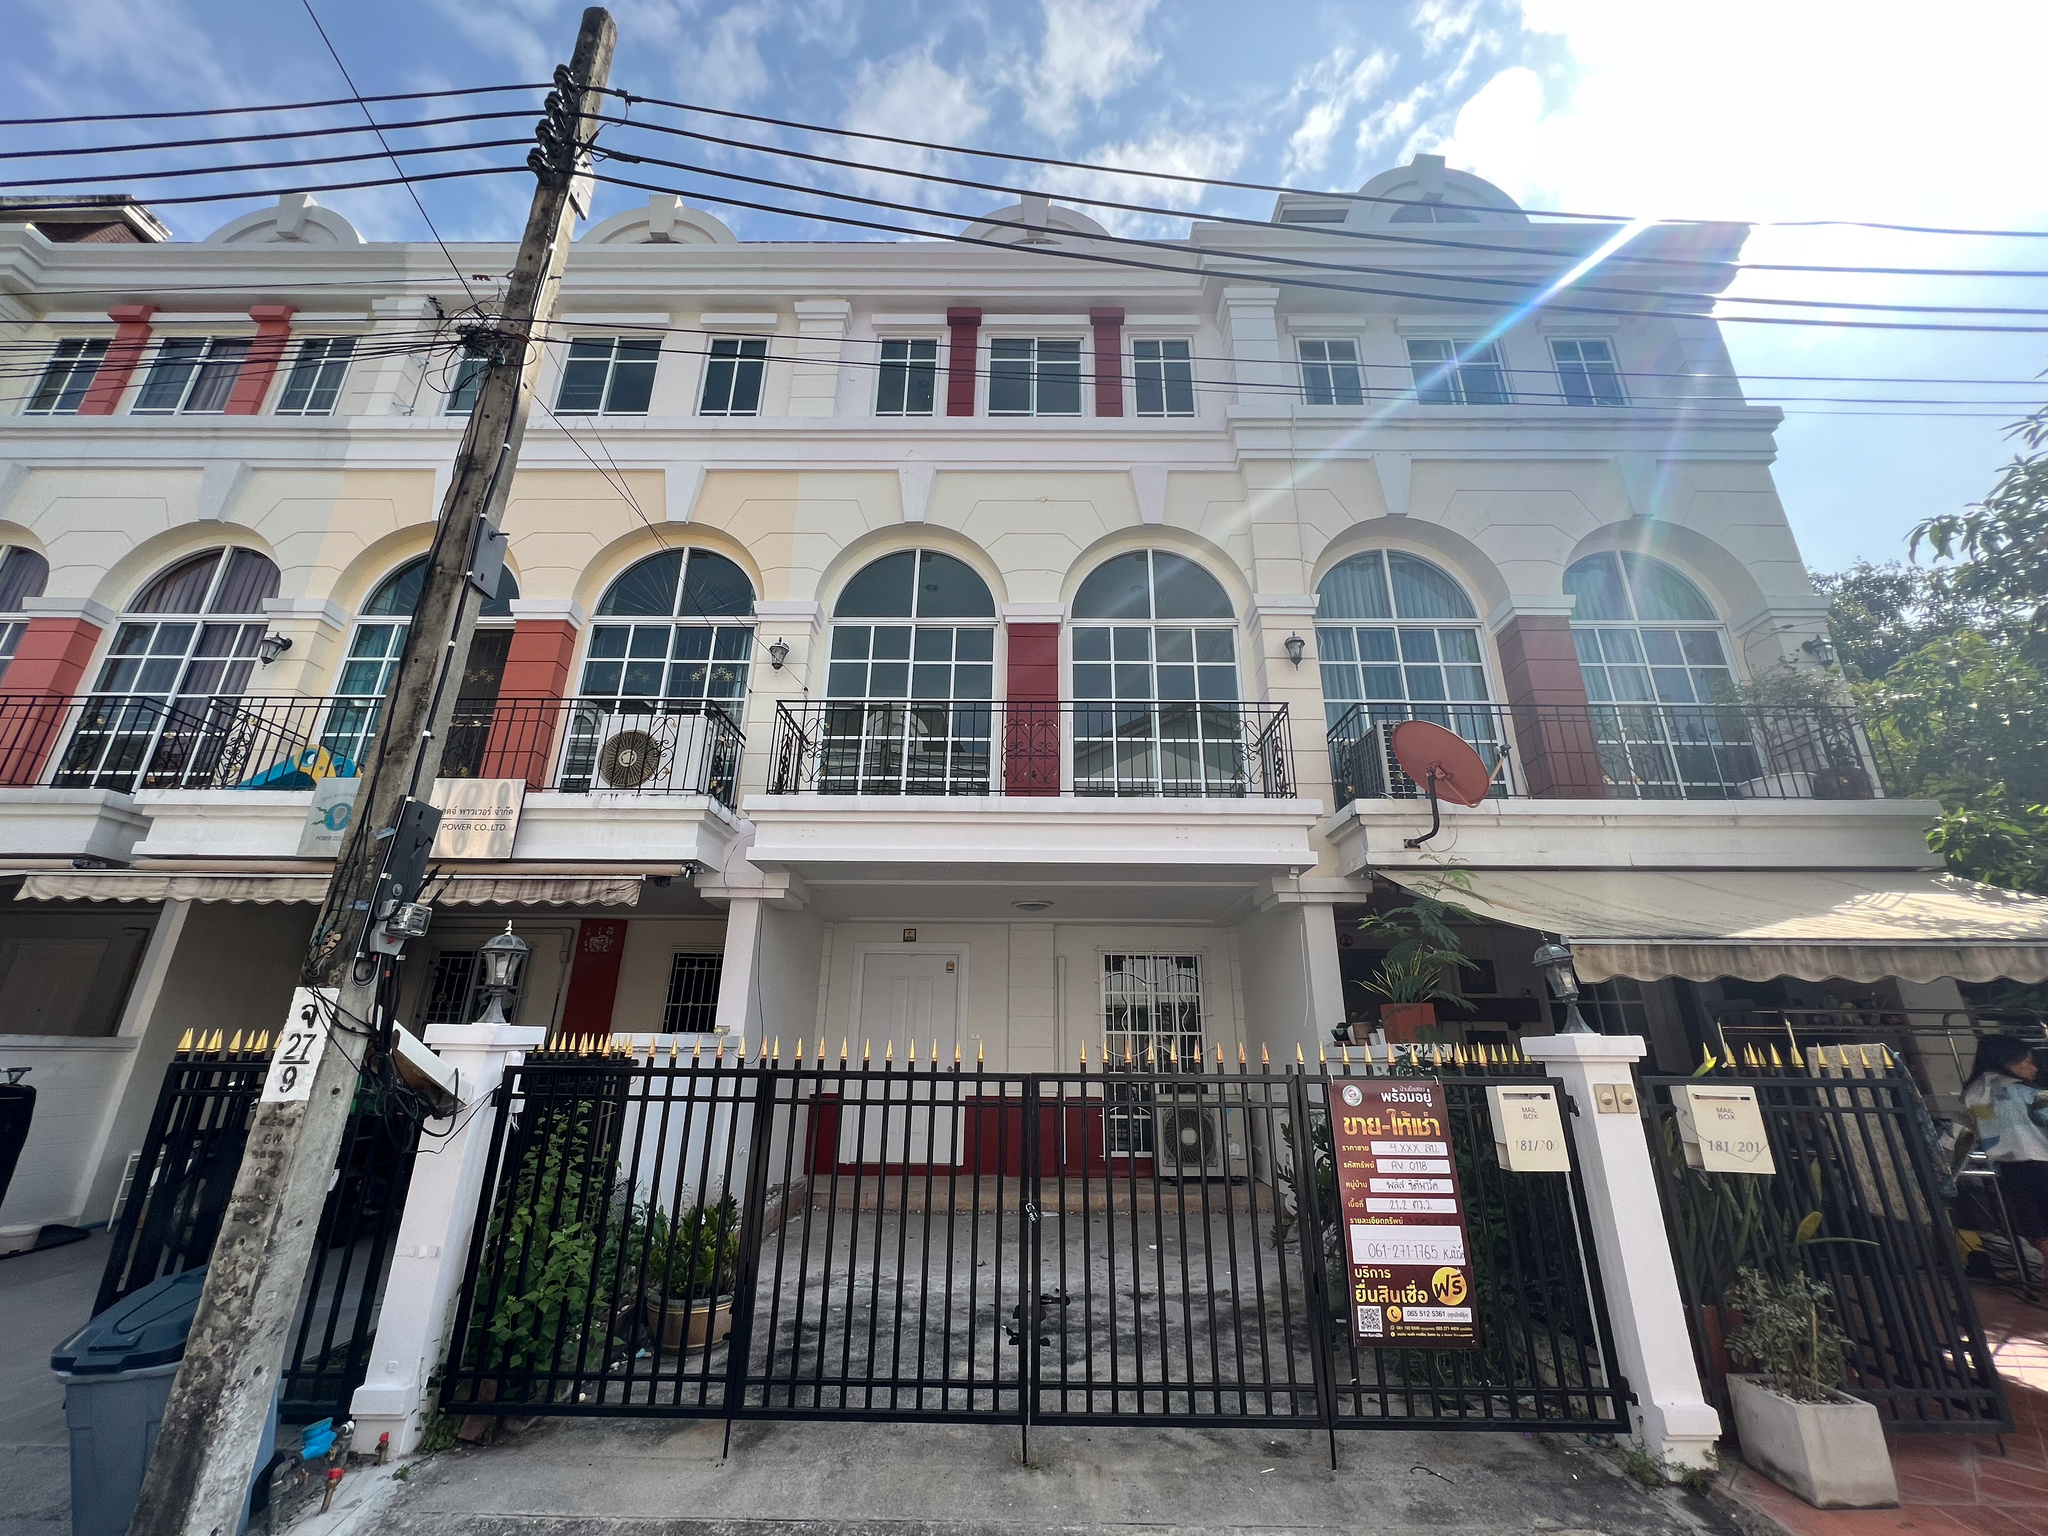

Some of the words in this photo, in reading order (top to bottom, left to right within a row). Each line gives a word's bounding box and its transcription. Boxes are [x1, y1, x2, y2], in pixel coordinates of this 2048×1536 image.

[494, 806, 514, 816] จำกัด
[442, 823, 472, 831] POWER
[474, 823, 507, 832] CO.,LTD.
[283, 1033, 317, 1060] 27
[279, 1066, 298, 1093] 9
[1380, 1087, 1433, 1107] พร้อมอยู่
[1343, 1108, 1441, 1136] ขาย-ให้เช่า
[1345, 1178, 1368, 1191] หมู่บ้าน
[1354, 1265, 1392, 1279] บริการ
[1355, 1279, 1429, 1304] ยื่นสินเชื่อ
[1433, 1273, 1463, 1299] ฟรี
